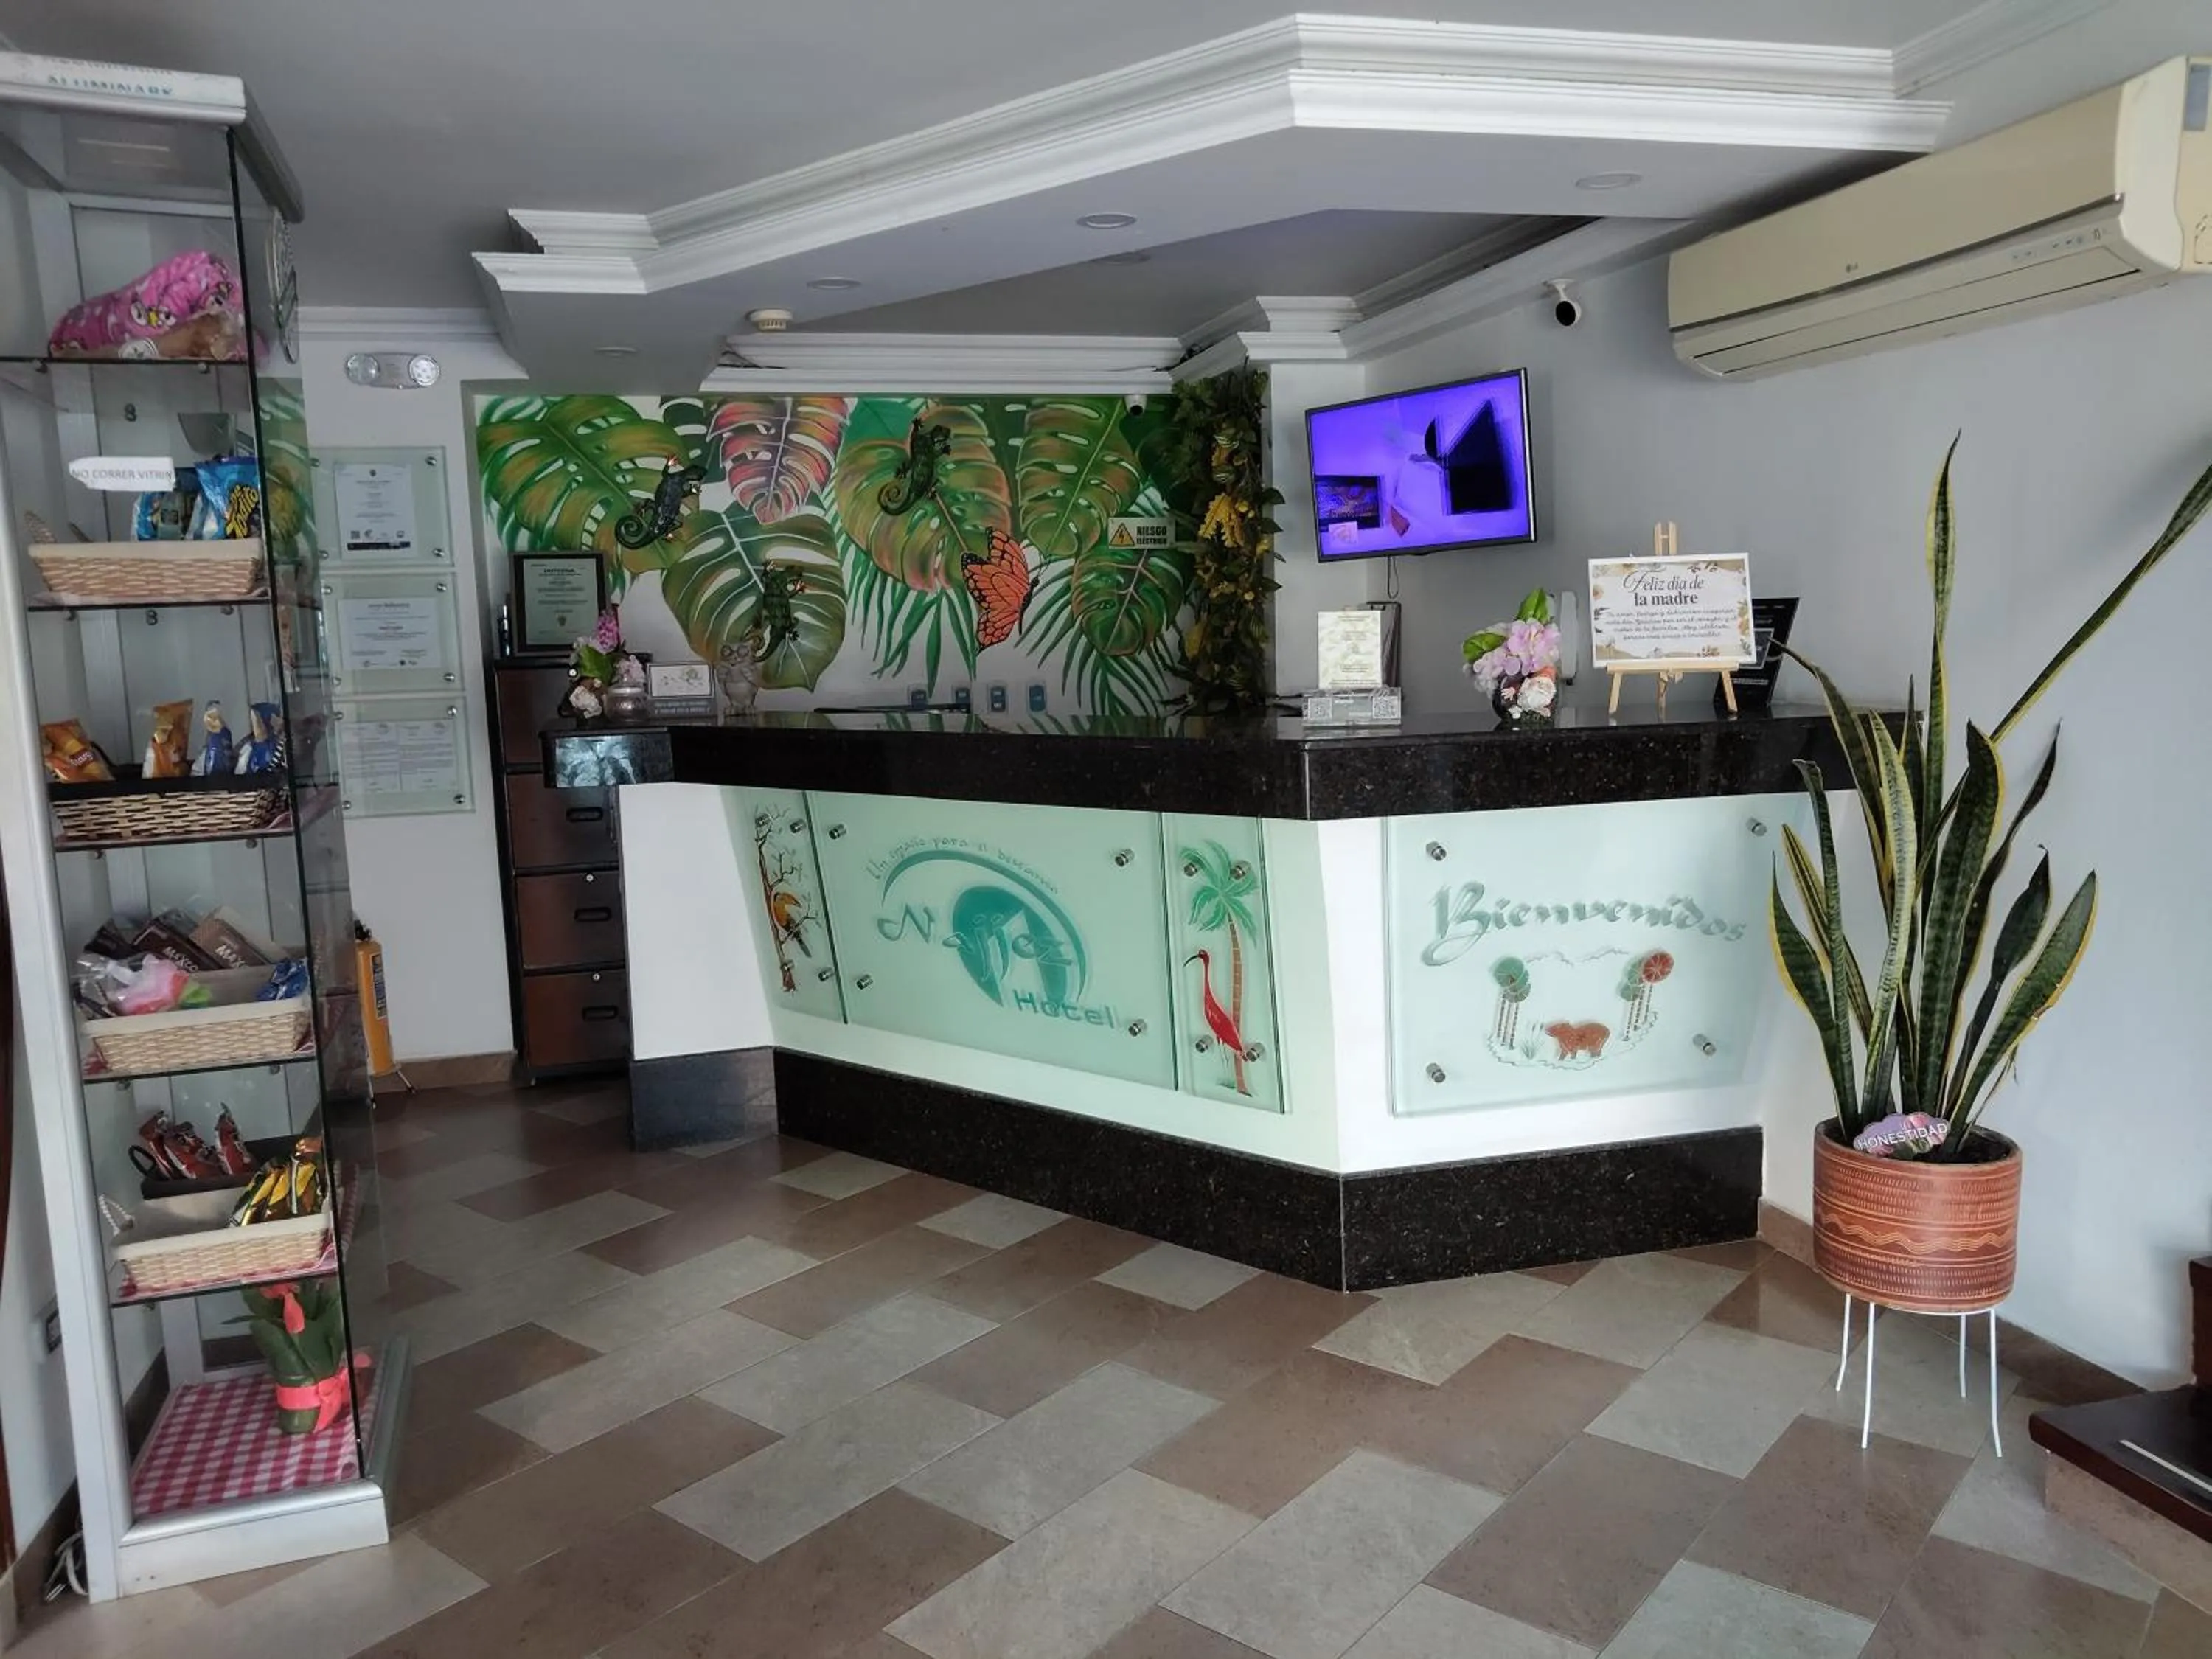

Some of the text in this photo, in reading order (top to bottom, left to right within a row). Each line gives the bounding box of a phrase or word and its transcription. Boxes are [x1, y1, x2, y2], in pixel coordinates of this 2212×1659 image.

[1623, 566, 1666, 593] Feliz
[1690, 574, 1705, 590] de
[1634, 591, 1699, 607] la madre
[1421, 880, 1747, 967] Bienvenidos
[1013, 988, 1118, 1029] Hotel
[1857, 1123, 1947, 1149] HONESTIDAD
